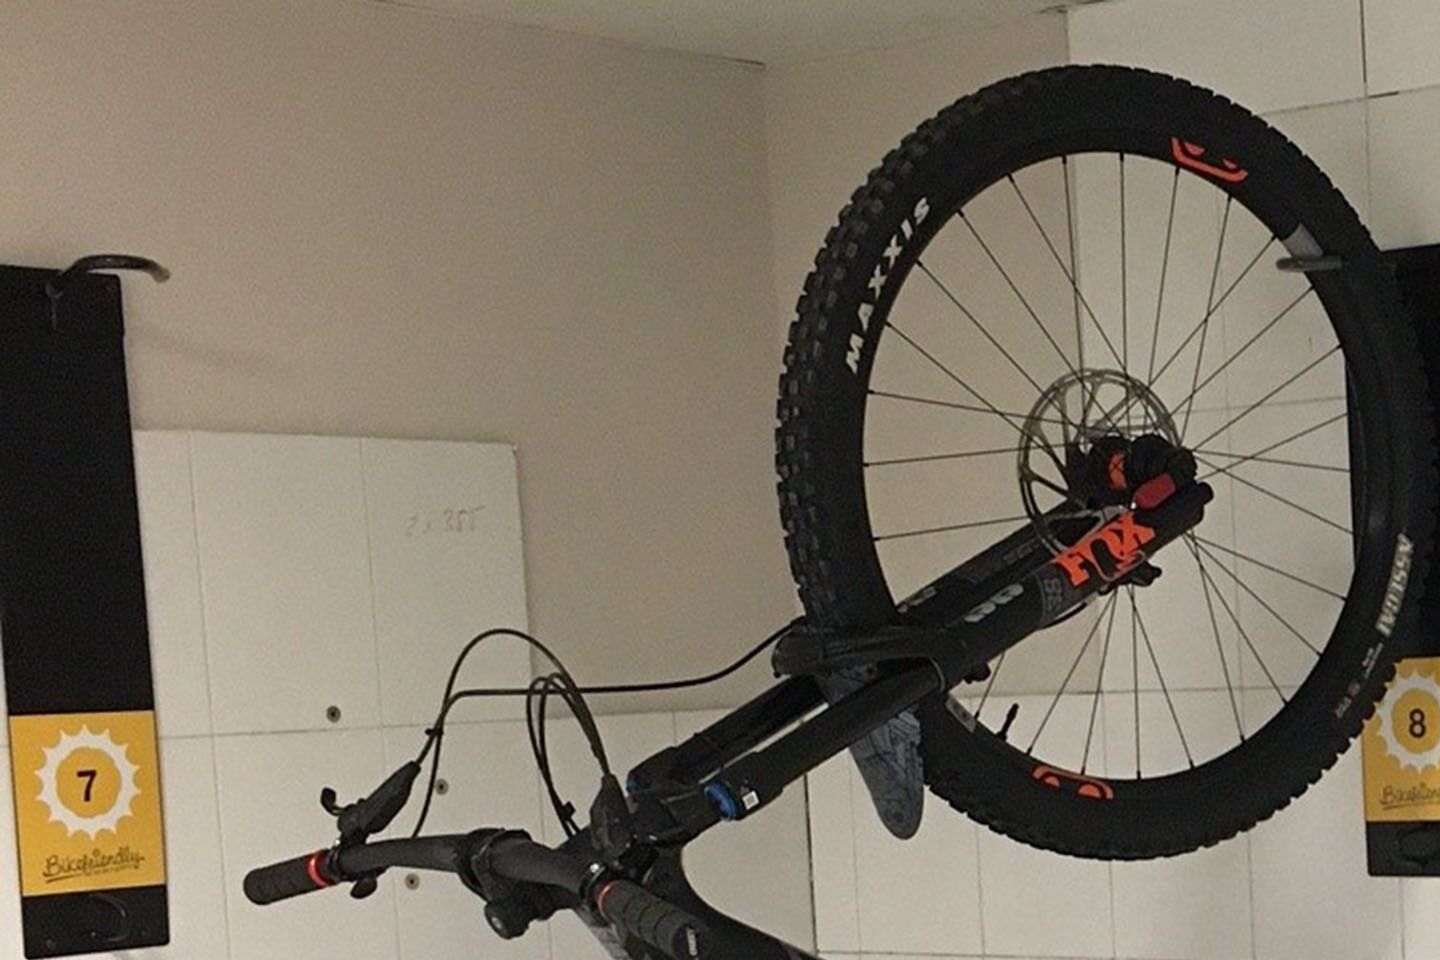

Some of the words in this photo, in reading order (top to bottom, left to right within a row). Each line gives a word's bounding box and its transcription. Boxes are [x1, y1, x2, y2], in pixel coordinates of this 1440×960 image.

[845, 197, 930, 375] MAXXIS
[1050, 510, 1157, 587] FOX
[1409, 708, 1426, 738] 8
[77, 769, 97, 802] 7
